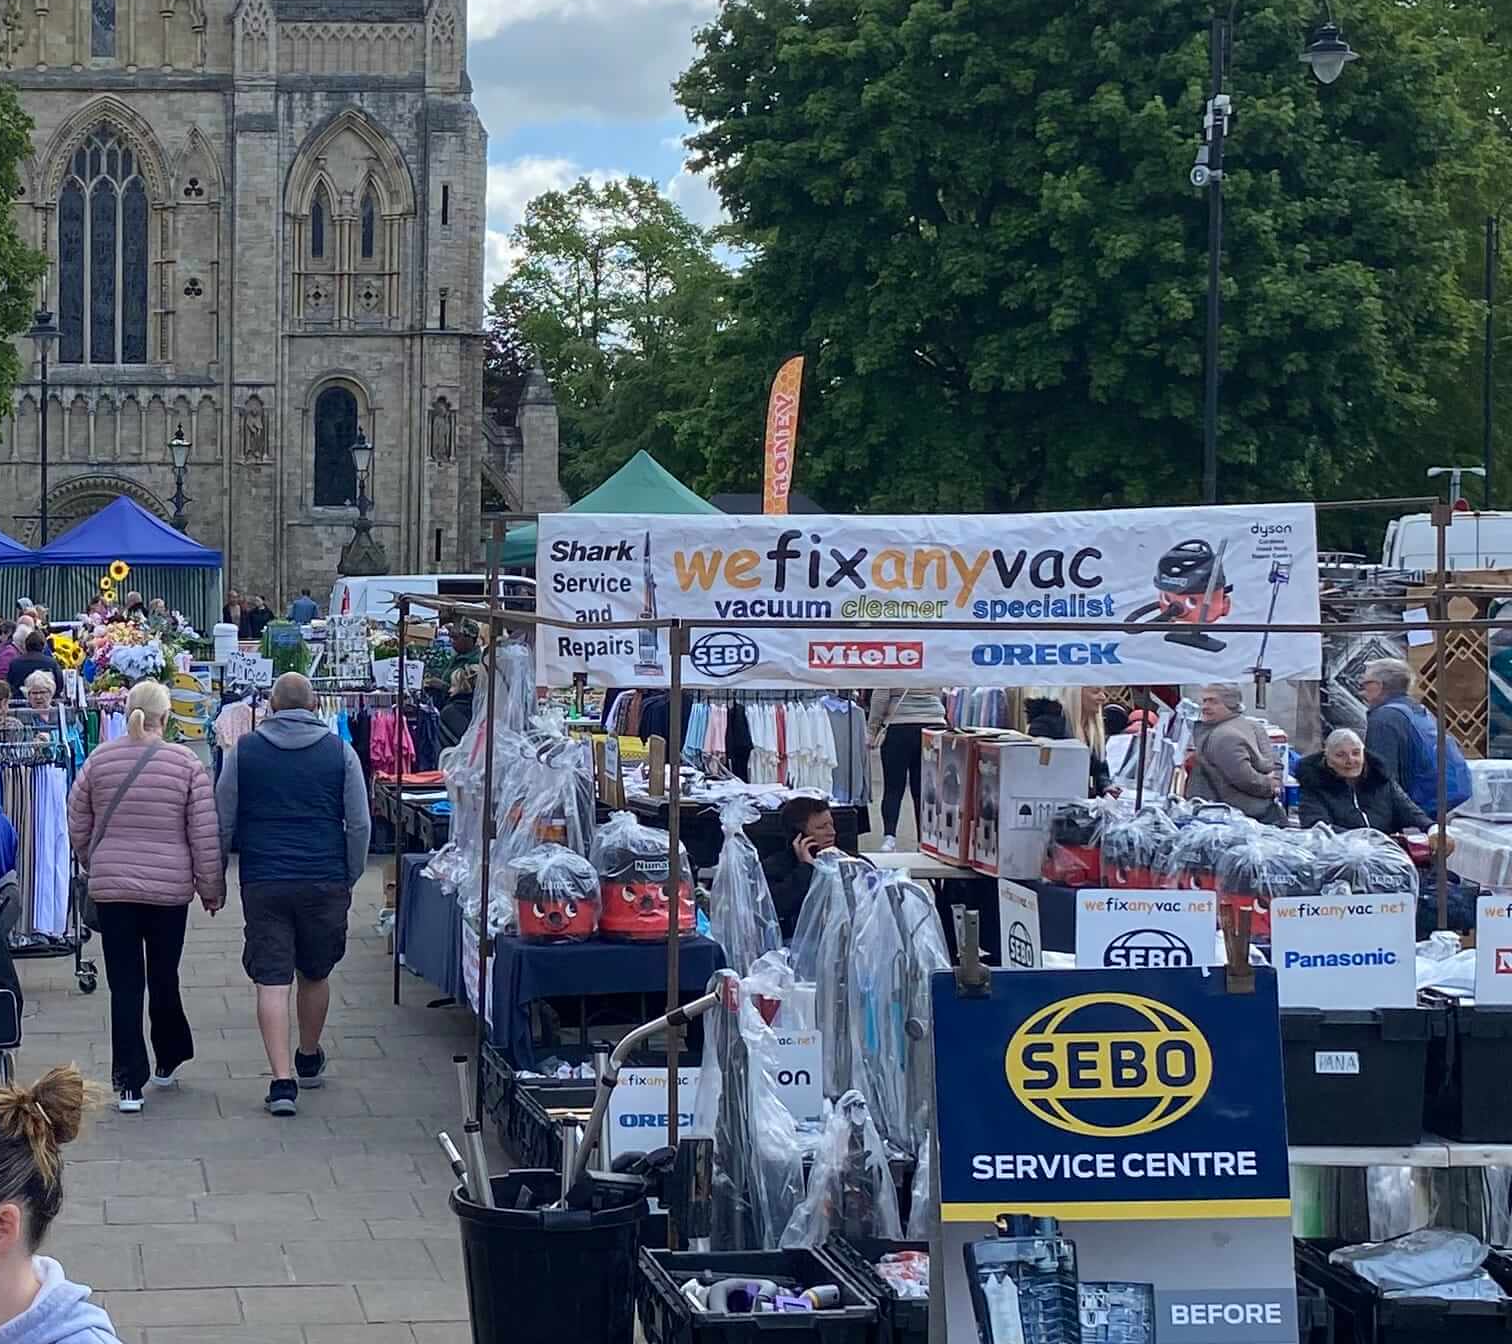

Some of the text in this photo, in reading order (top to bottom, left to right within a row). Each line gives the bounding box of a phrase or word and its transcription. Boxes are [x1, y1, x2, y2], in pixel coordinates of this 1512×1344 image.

[774, 393, 794, 496] HONEY
[1250, 522, 1293, 538] dyson
[549, 540, 637, 563] Shark
[672, 528, 1103, 608] wefixanyvac
[552, 572, 632, 594] Service
[575, 604, 612, 623] and
[714, 592, 1116, 621] vacuum cleaner specialist
[557, 636, 635, 662] Repairs
[693, 644, 756, 664] SEBO
[810, 644, 921, 667] Miele
[971, 641, 1123, 666] ORECK
[1284, 947, 1397, 969] Panasonic
[1021, 1038, 1199, 1092] SEBO
[971, 1149, 1258, 1181] SERVICE CENTRE
[1170, 1301, 1282, 1327] BEFORE
